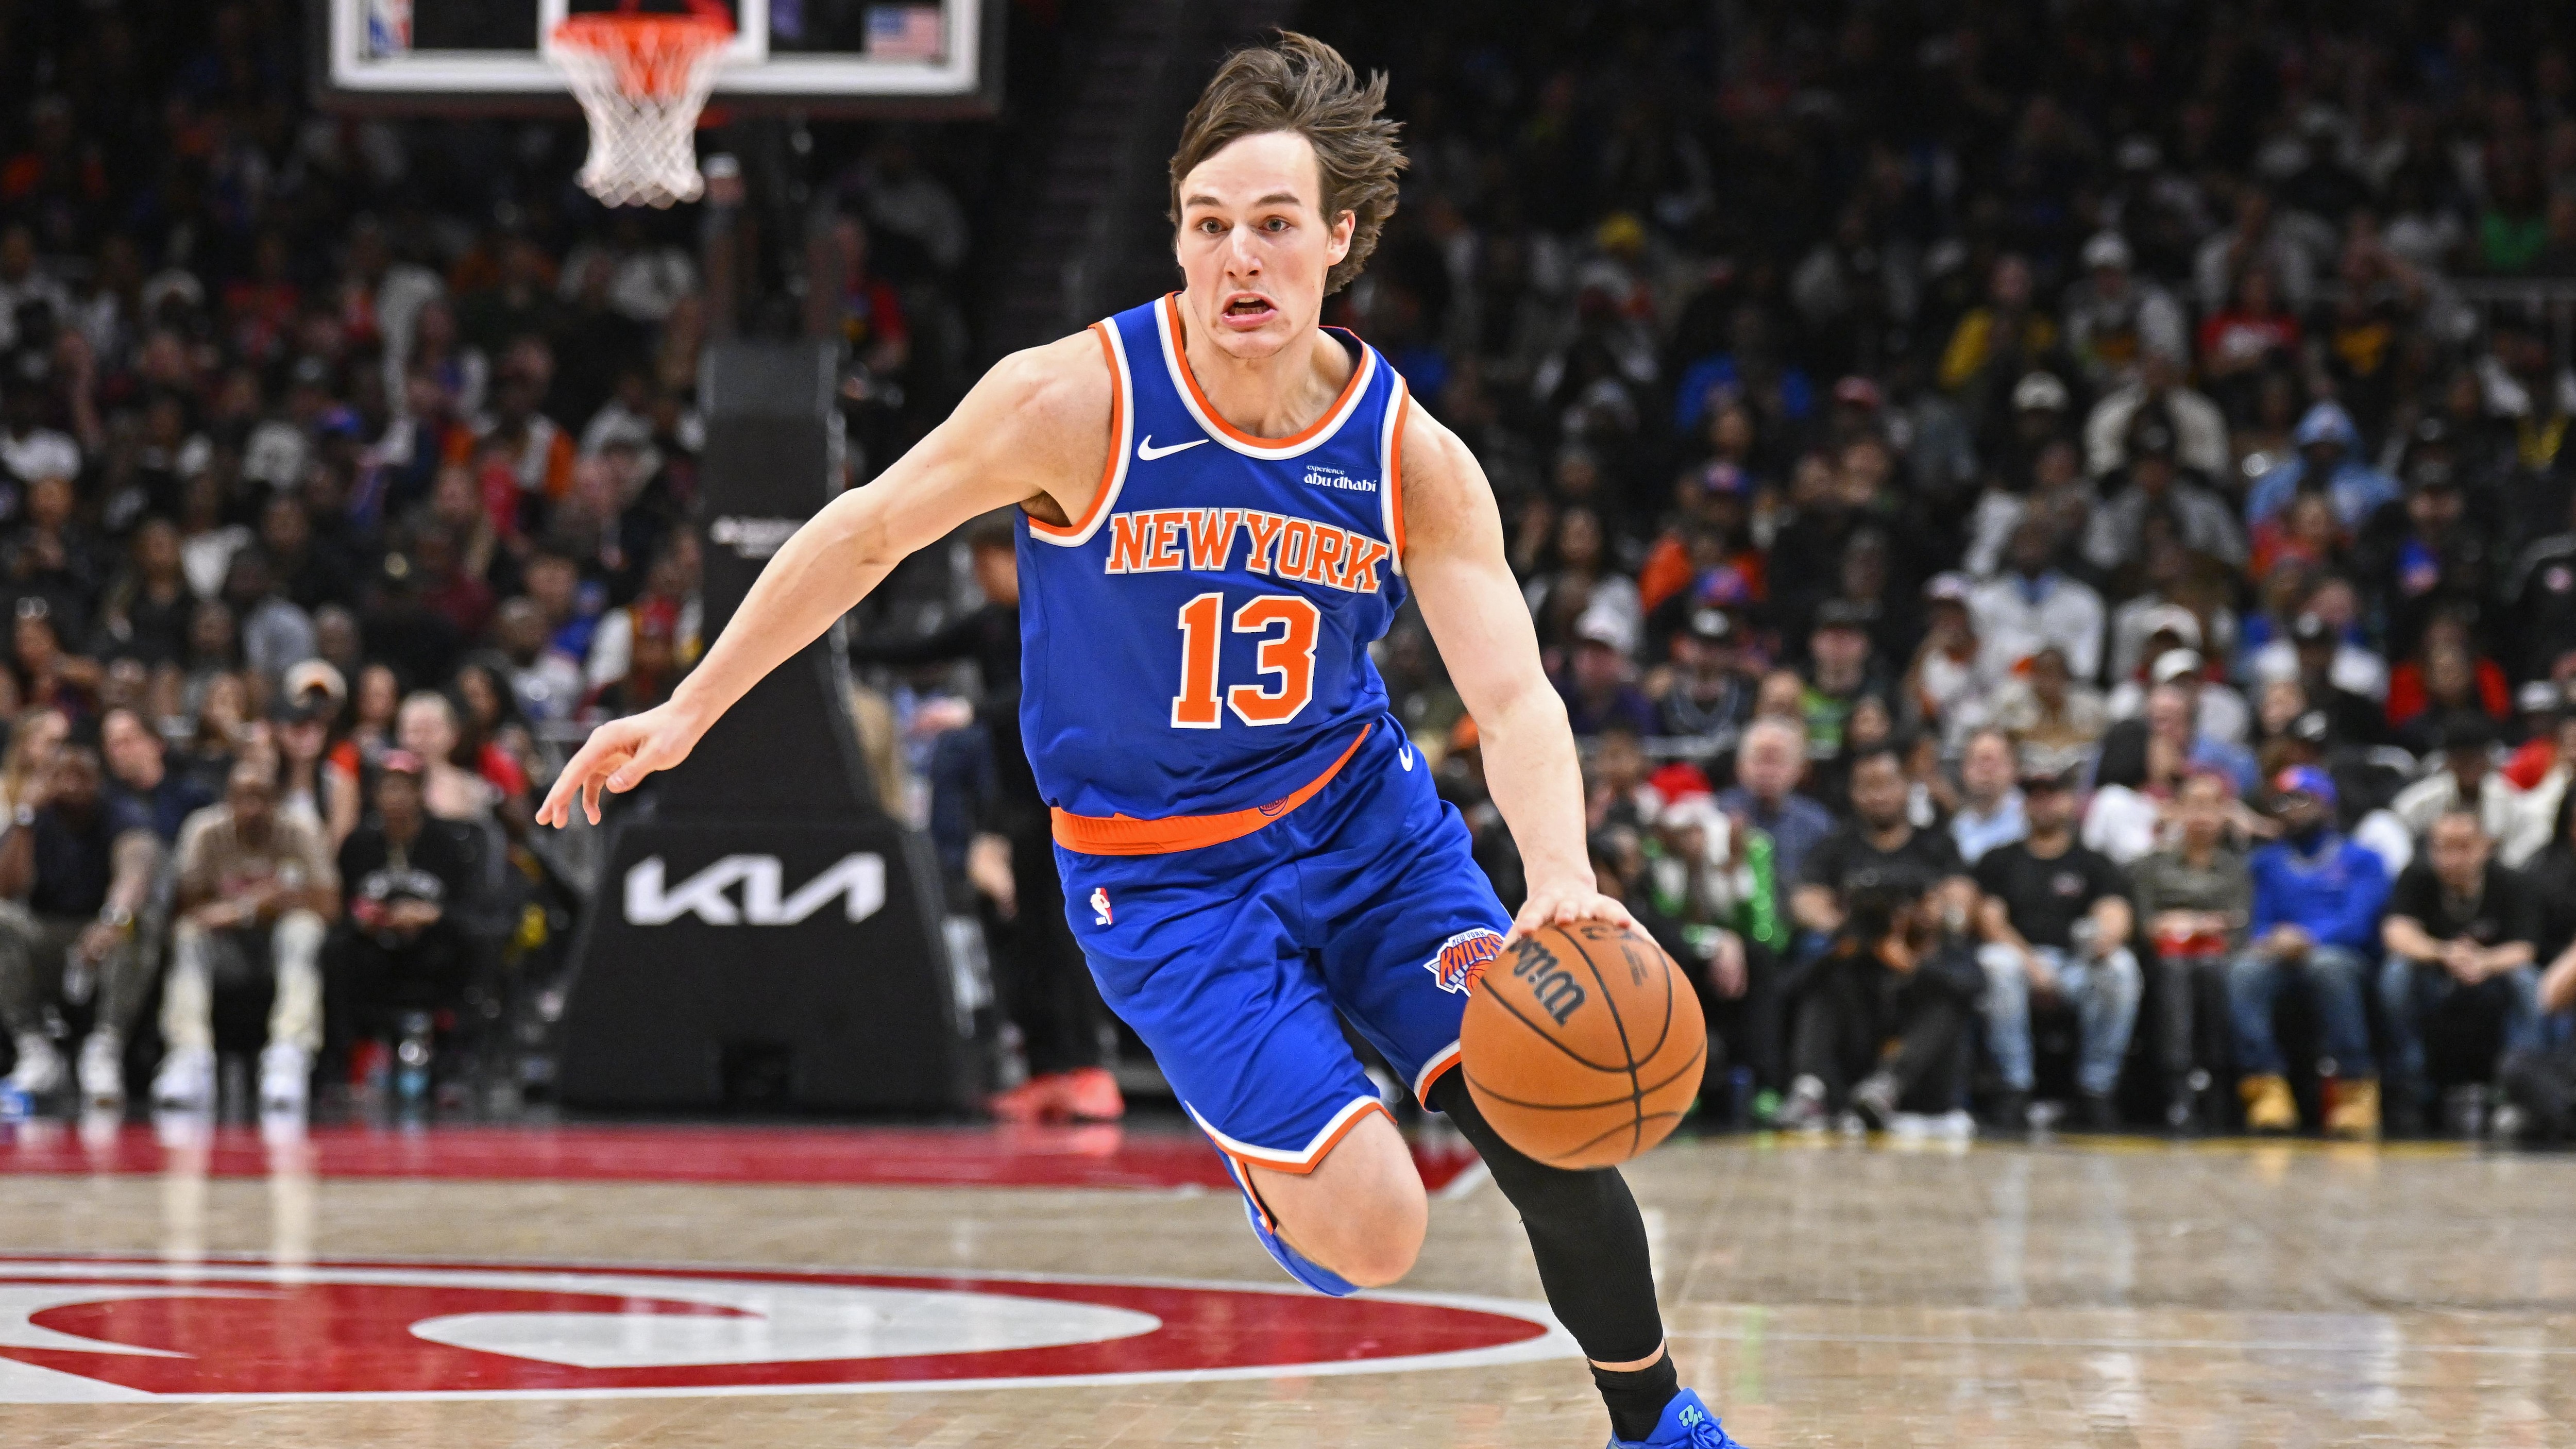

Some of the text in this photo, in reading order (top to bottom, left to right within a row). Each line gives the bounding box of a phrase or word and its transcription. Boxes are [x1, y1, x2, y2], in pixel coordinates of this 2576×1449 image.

[1304, 473, 1377, 492] abu dhabi
[1307, 465, 1345, 475] experience
[1105, 508, 1391, 594] NEW YORK
[1171, 592, 1321, 729] 13
[622, 852, 886, 926] KIA
[1452, 931, 1486, 947] NEW YORK
